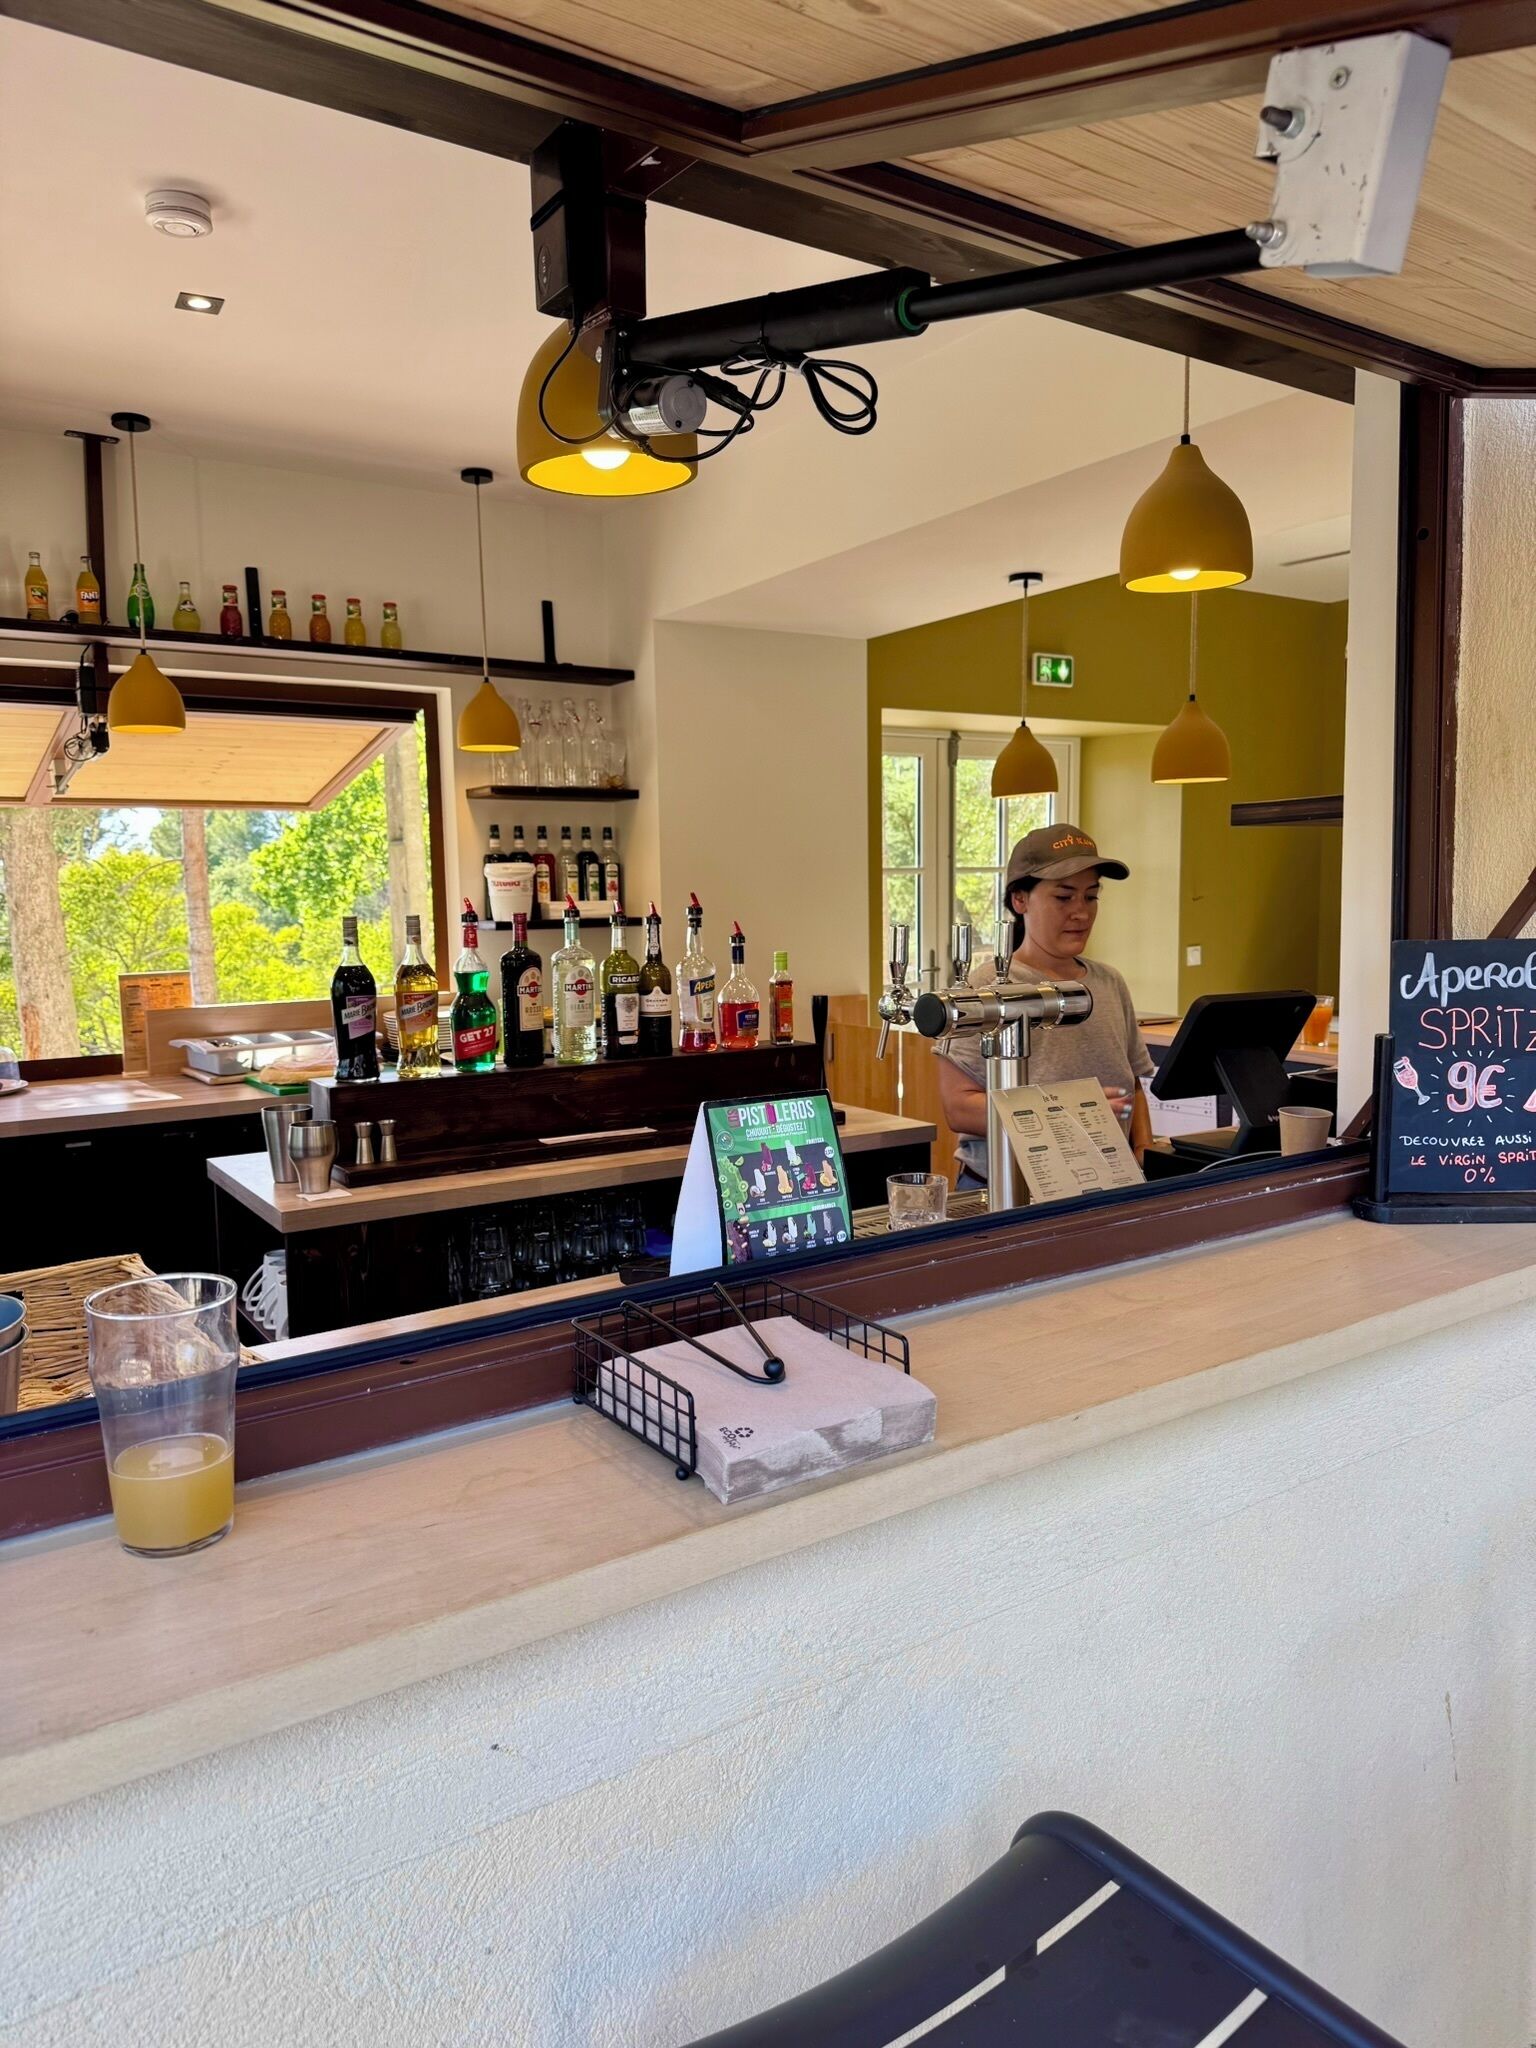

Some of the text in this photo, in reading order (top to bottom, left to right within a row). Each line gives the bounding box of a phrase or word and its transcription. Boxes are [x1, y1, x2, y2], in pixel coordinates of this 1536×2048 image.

[460, 1025, 494, 1043] GET 27
[1446, 1060, 1506, 1113] 9€
[1399, 1135, 1486, 1147] DECOUVREZ
[1410, 1155, 1426, 1166] LE
